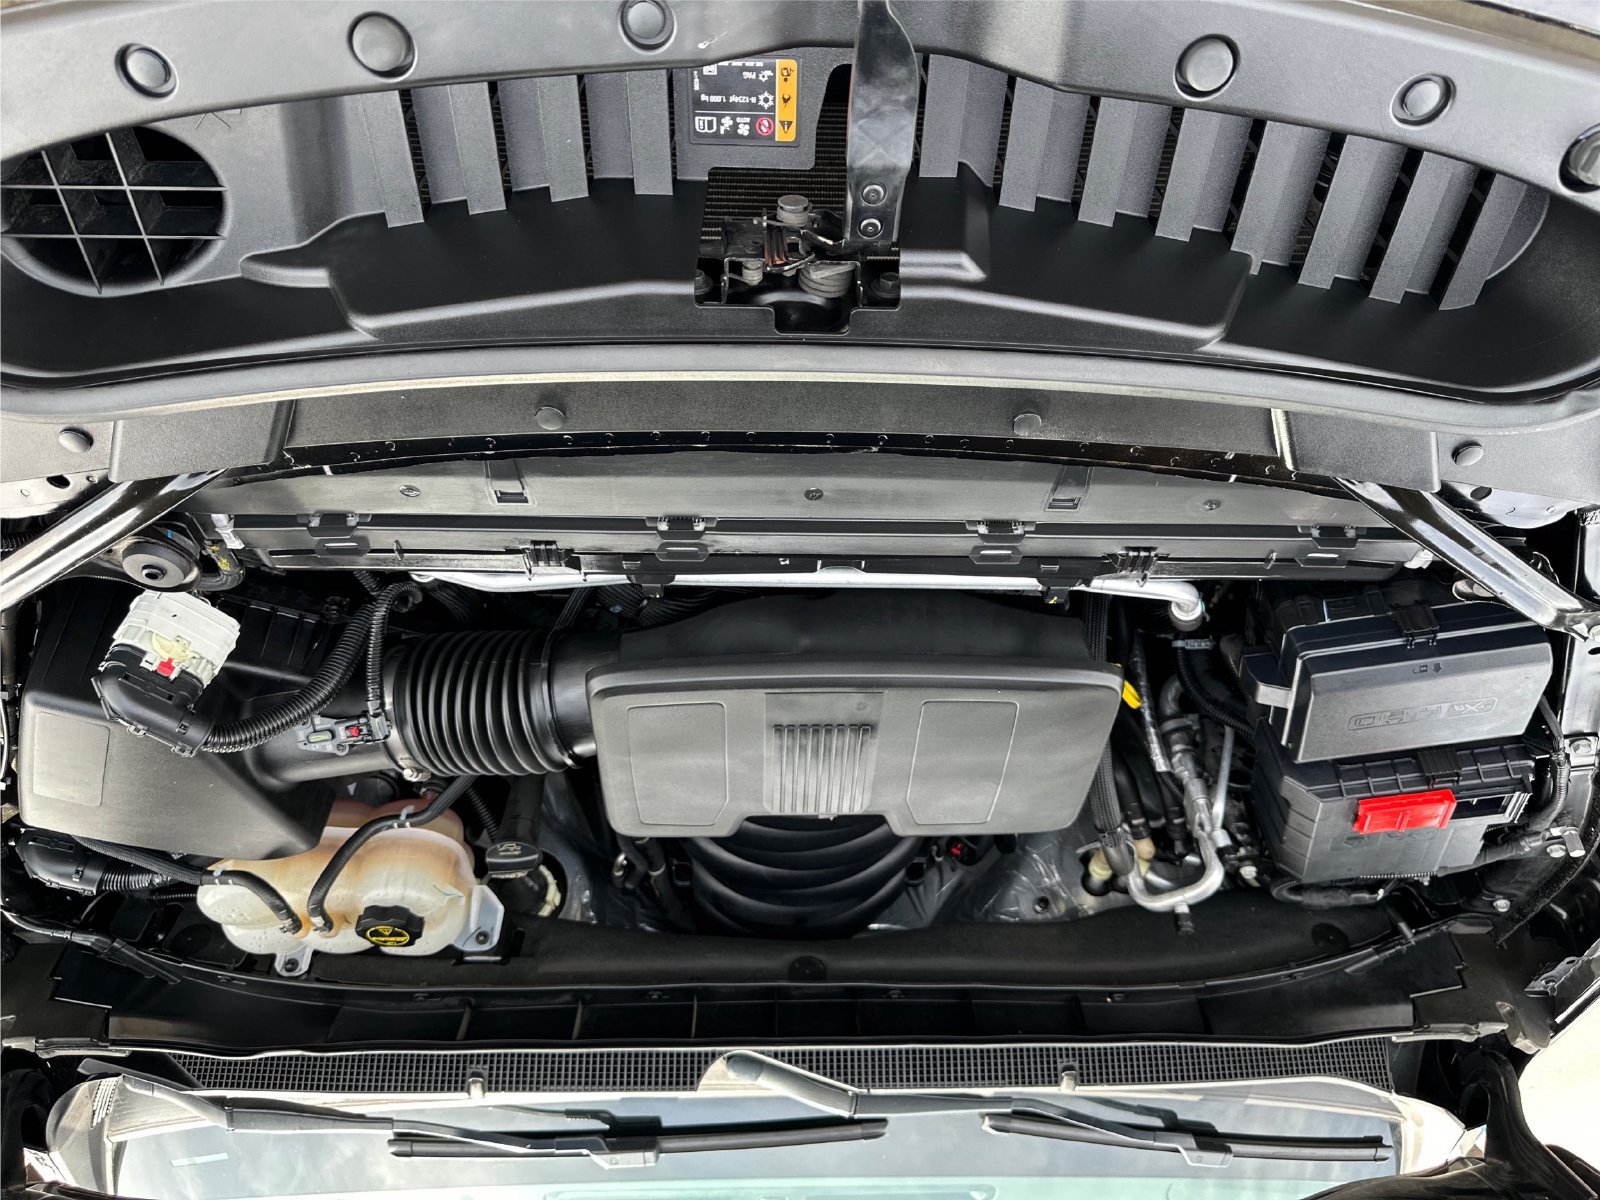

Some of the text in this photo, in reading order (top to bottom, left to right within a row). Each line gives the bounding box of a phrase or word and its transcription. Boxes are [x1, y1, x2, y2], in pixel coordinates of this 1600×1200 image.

[742, 71, 756, 79] PAG
[700, 94, 709, 103] kg
[729, 94, 756, 103] R-1234yf
